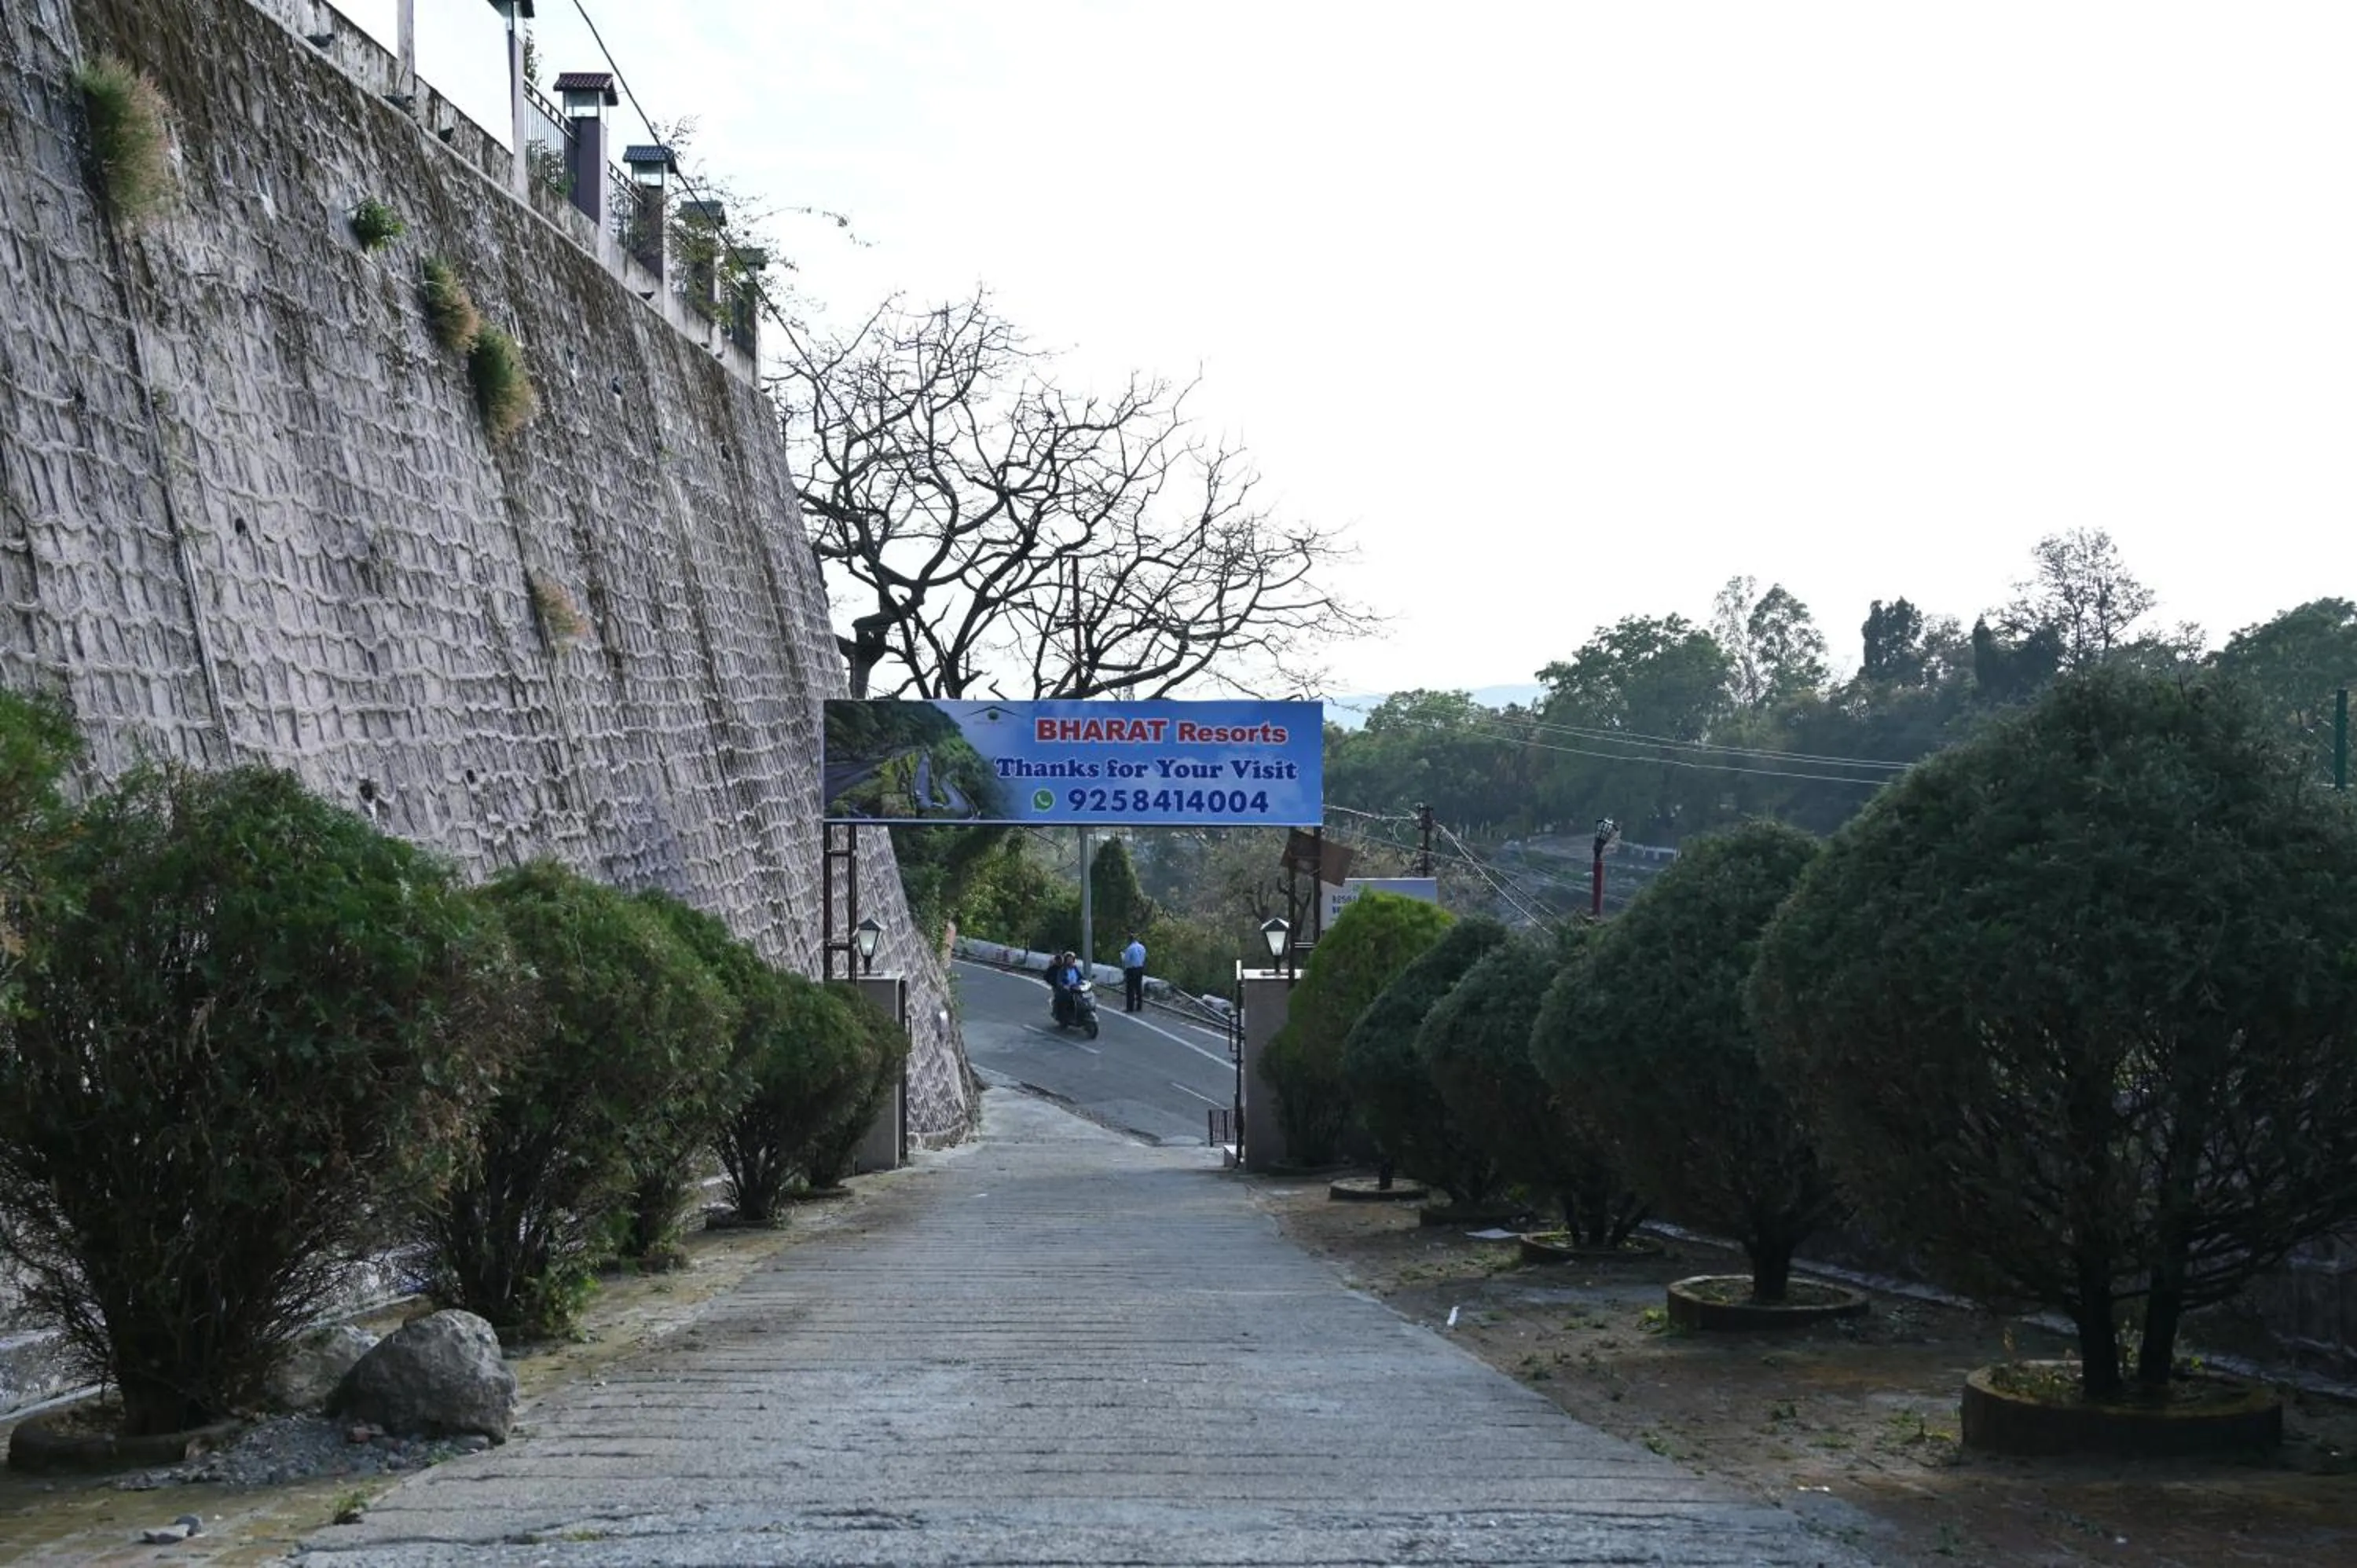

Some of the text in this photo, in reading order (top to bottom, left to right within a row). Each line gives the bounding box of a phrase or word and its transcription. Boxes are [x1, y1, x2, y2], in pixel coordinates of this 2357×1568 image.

[1036, 718, 1287, 743] BHARAT Resorts
[996, 757, 1297, 780] Thanks for Your Visit
[1068, 788, 1270, 813] 9258414004
